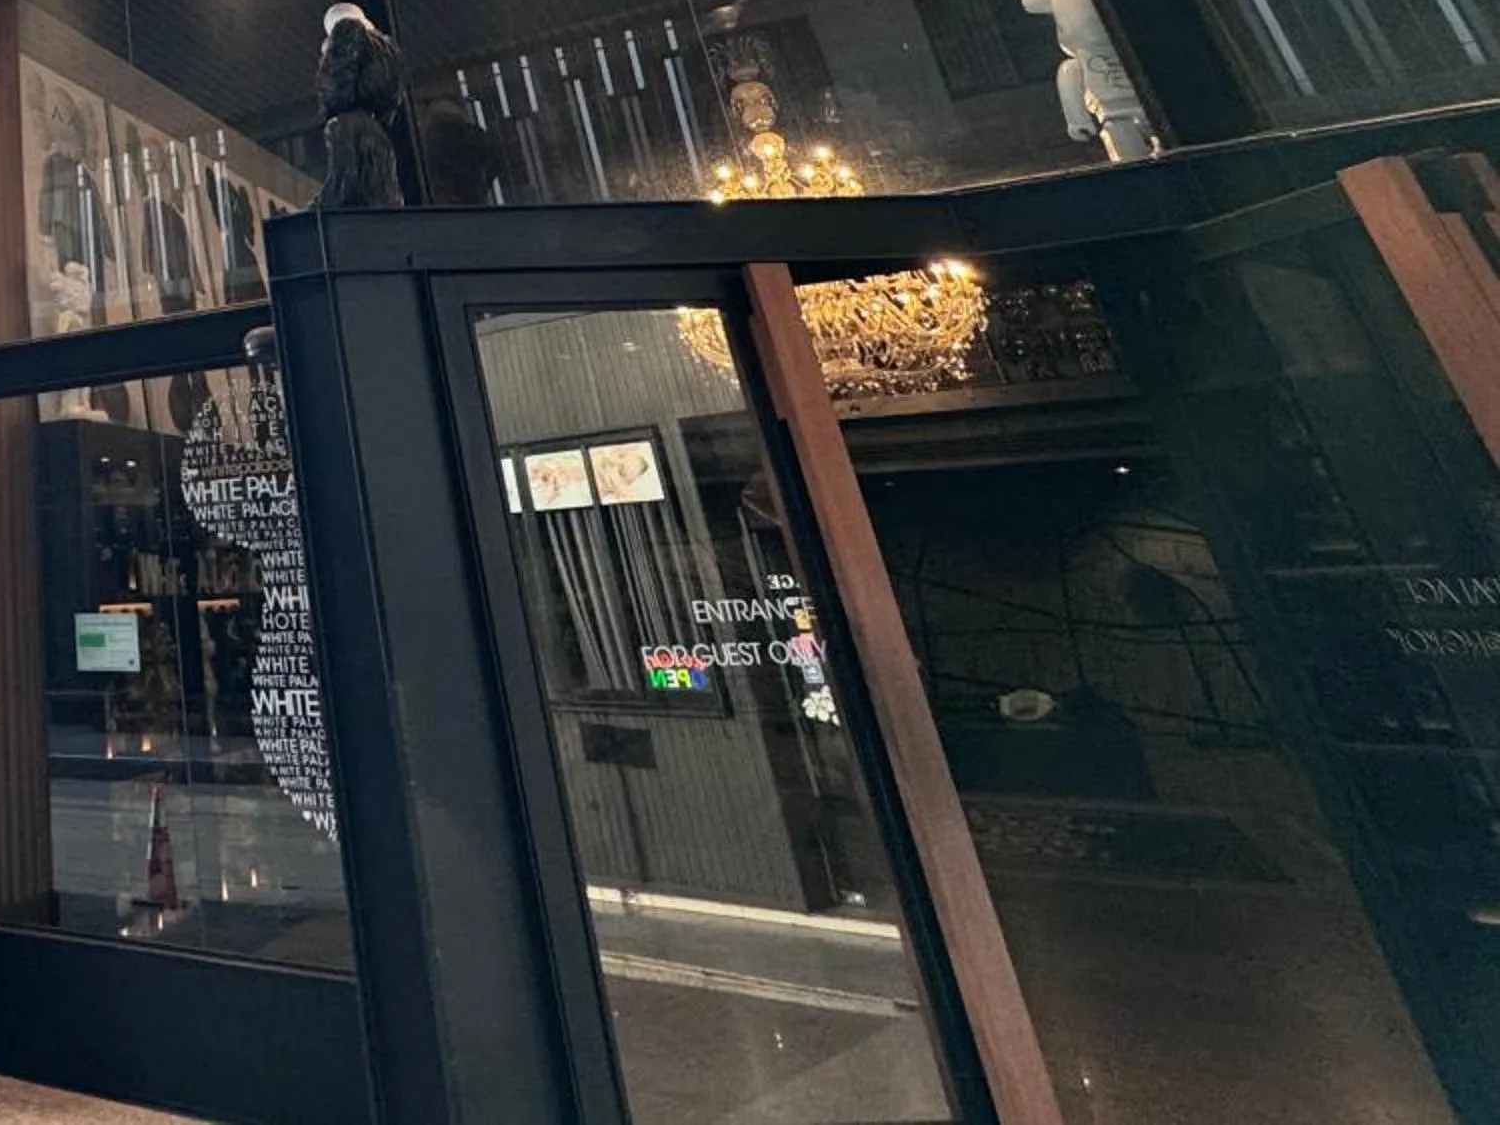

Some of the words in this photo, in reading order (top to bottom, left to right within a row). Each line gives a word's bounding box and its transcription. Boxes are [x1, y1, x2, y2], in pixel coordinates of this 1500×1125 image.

[181, 477, 243, 504] WHITE
[194, 504, 237, 521] WHITE
[208, 520, 245, 532] WHITE
[261, 550, 305, 568] WHITE
[262, 568, 306, 584] WHITE
[264, 585, 309, 611] WHI
[692, 596, 817, 623] ENTRANCE
[262, 612, 310, 630] HOTE
[261, 631, 296, 644] WHITE
[692, 641, 761, 667] GUEST
[257, 656, 310, 674] WHITE
[252, 674, 287, 687] WHITE
[289, 675, 320, 688] PALA
[251, 689, 321, 716] WHITE
[252, 716, 288, 728] WHITE
[258, 739, 299, 754] WHITE
[300, 738, 328, 754] PAL
[263, 753, 300, 766] WHITE
[278, 777, 313, 791] WHITE
[291, 792, 335, 808] WHITE
